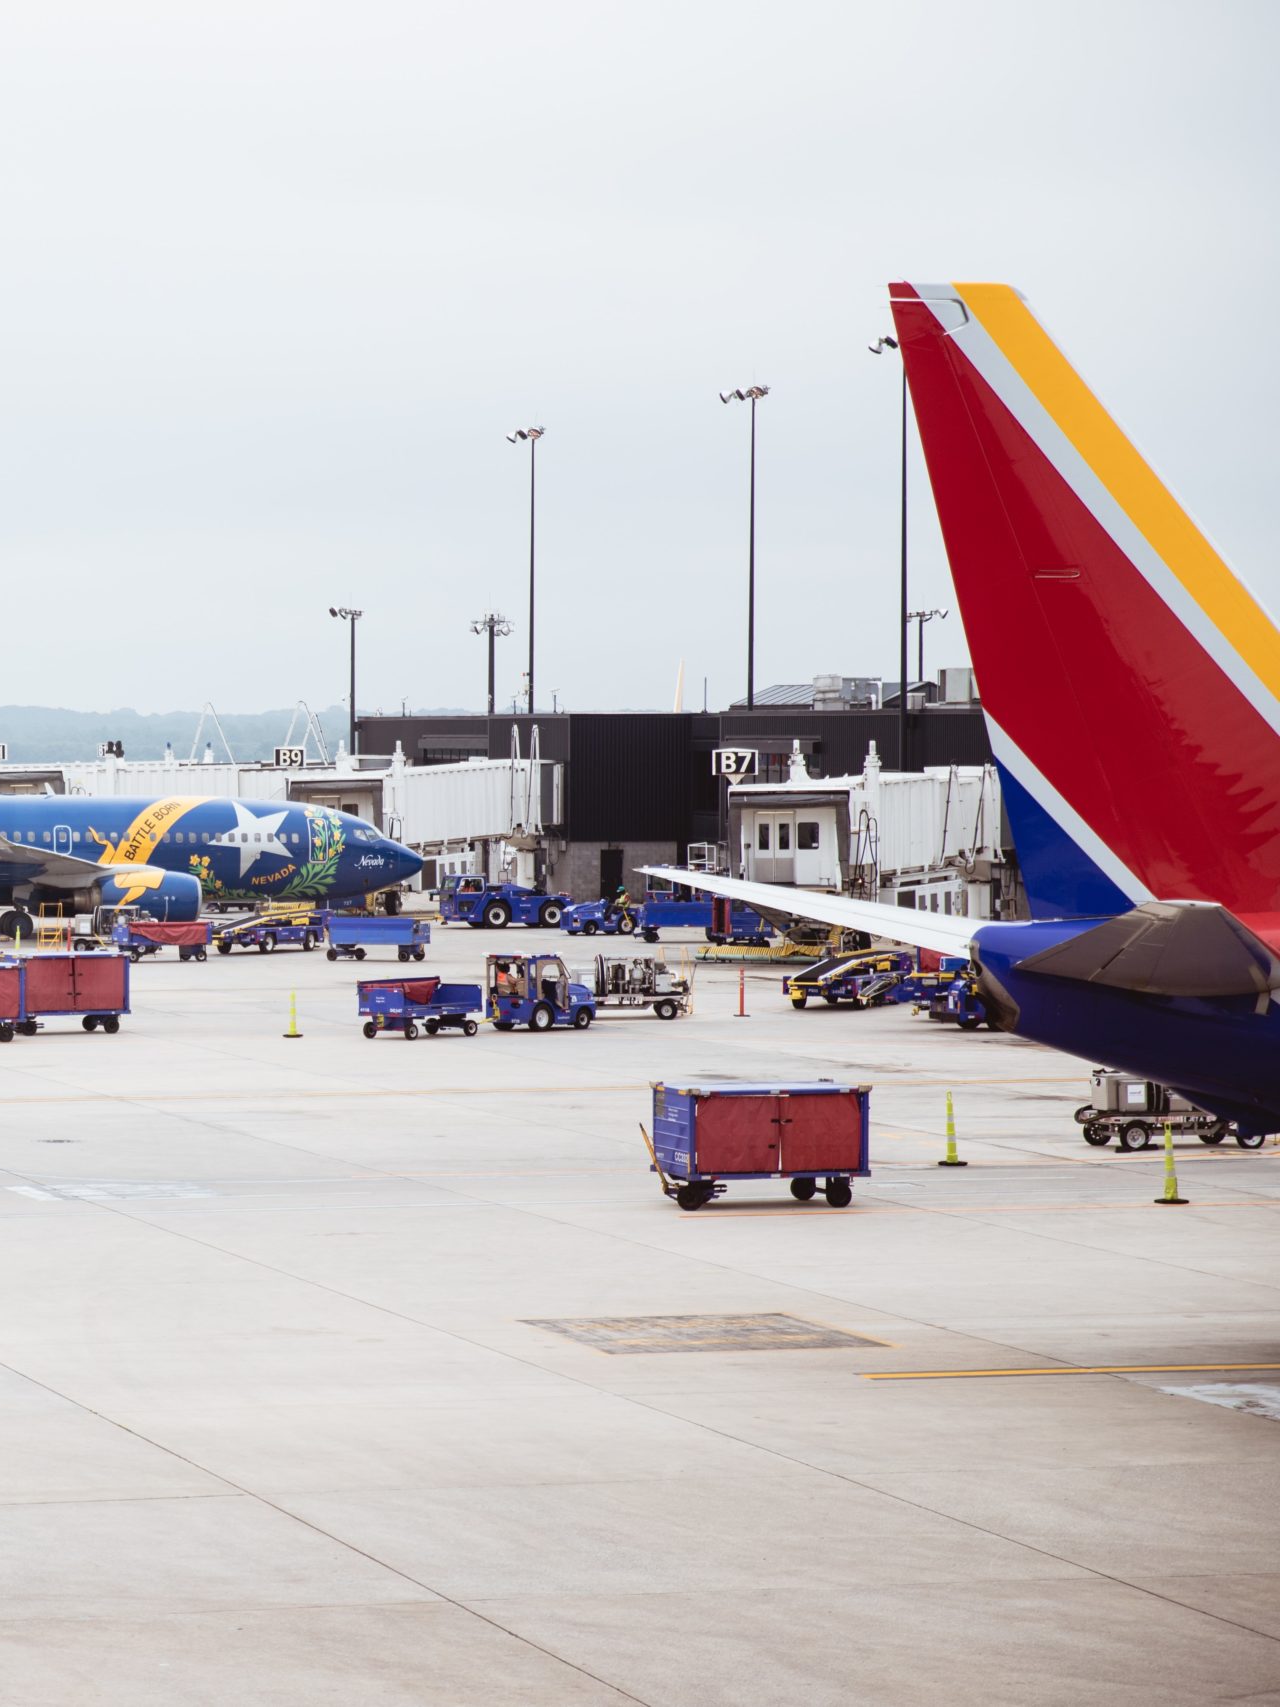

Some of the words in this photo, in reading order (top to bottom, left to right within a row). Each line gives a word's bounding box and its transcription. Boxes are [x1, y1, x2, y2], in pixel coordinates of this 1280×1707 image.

[280, 749, 301, 767] B9
[721, 752, 752, 773] B7
[124, 819, 156, 861] BATTLE
[152, 801, 181, 821] BORN
[354, 854, 385, 868] Nevada
[251, 863, 296, 885] NEVADA
